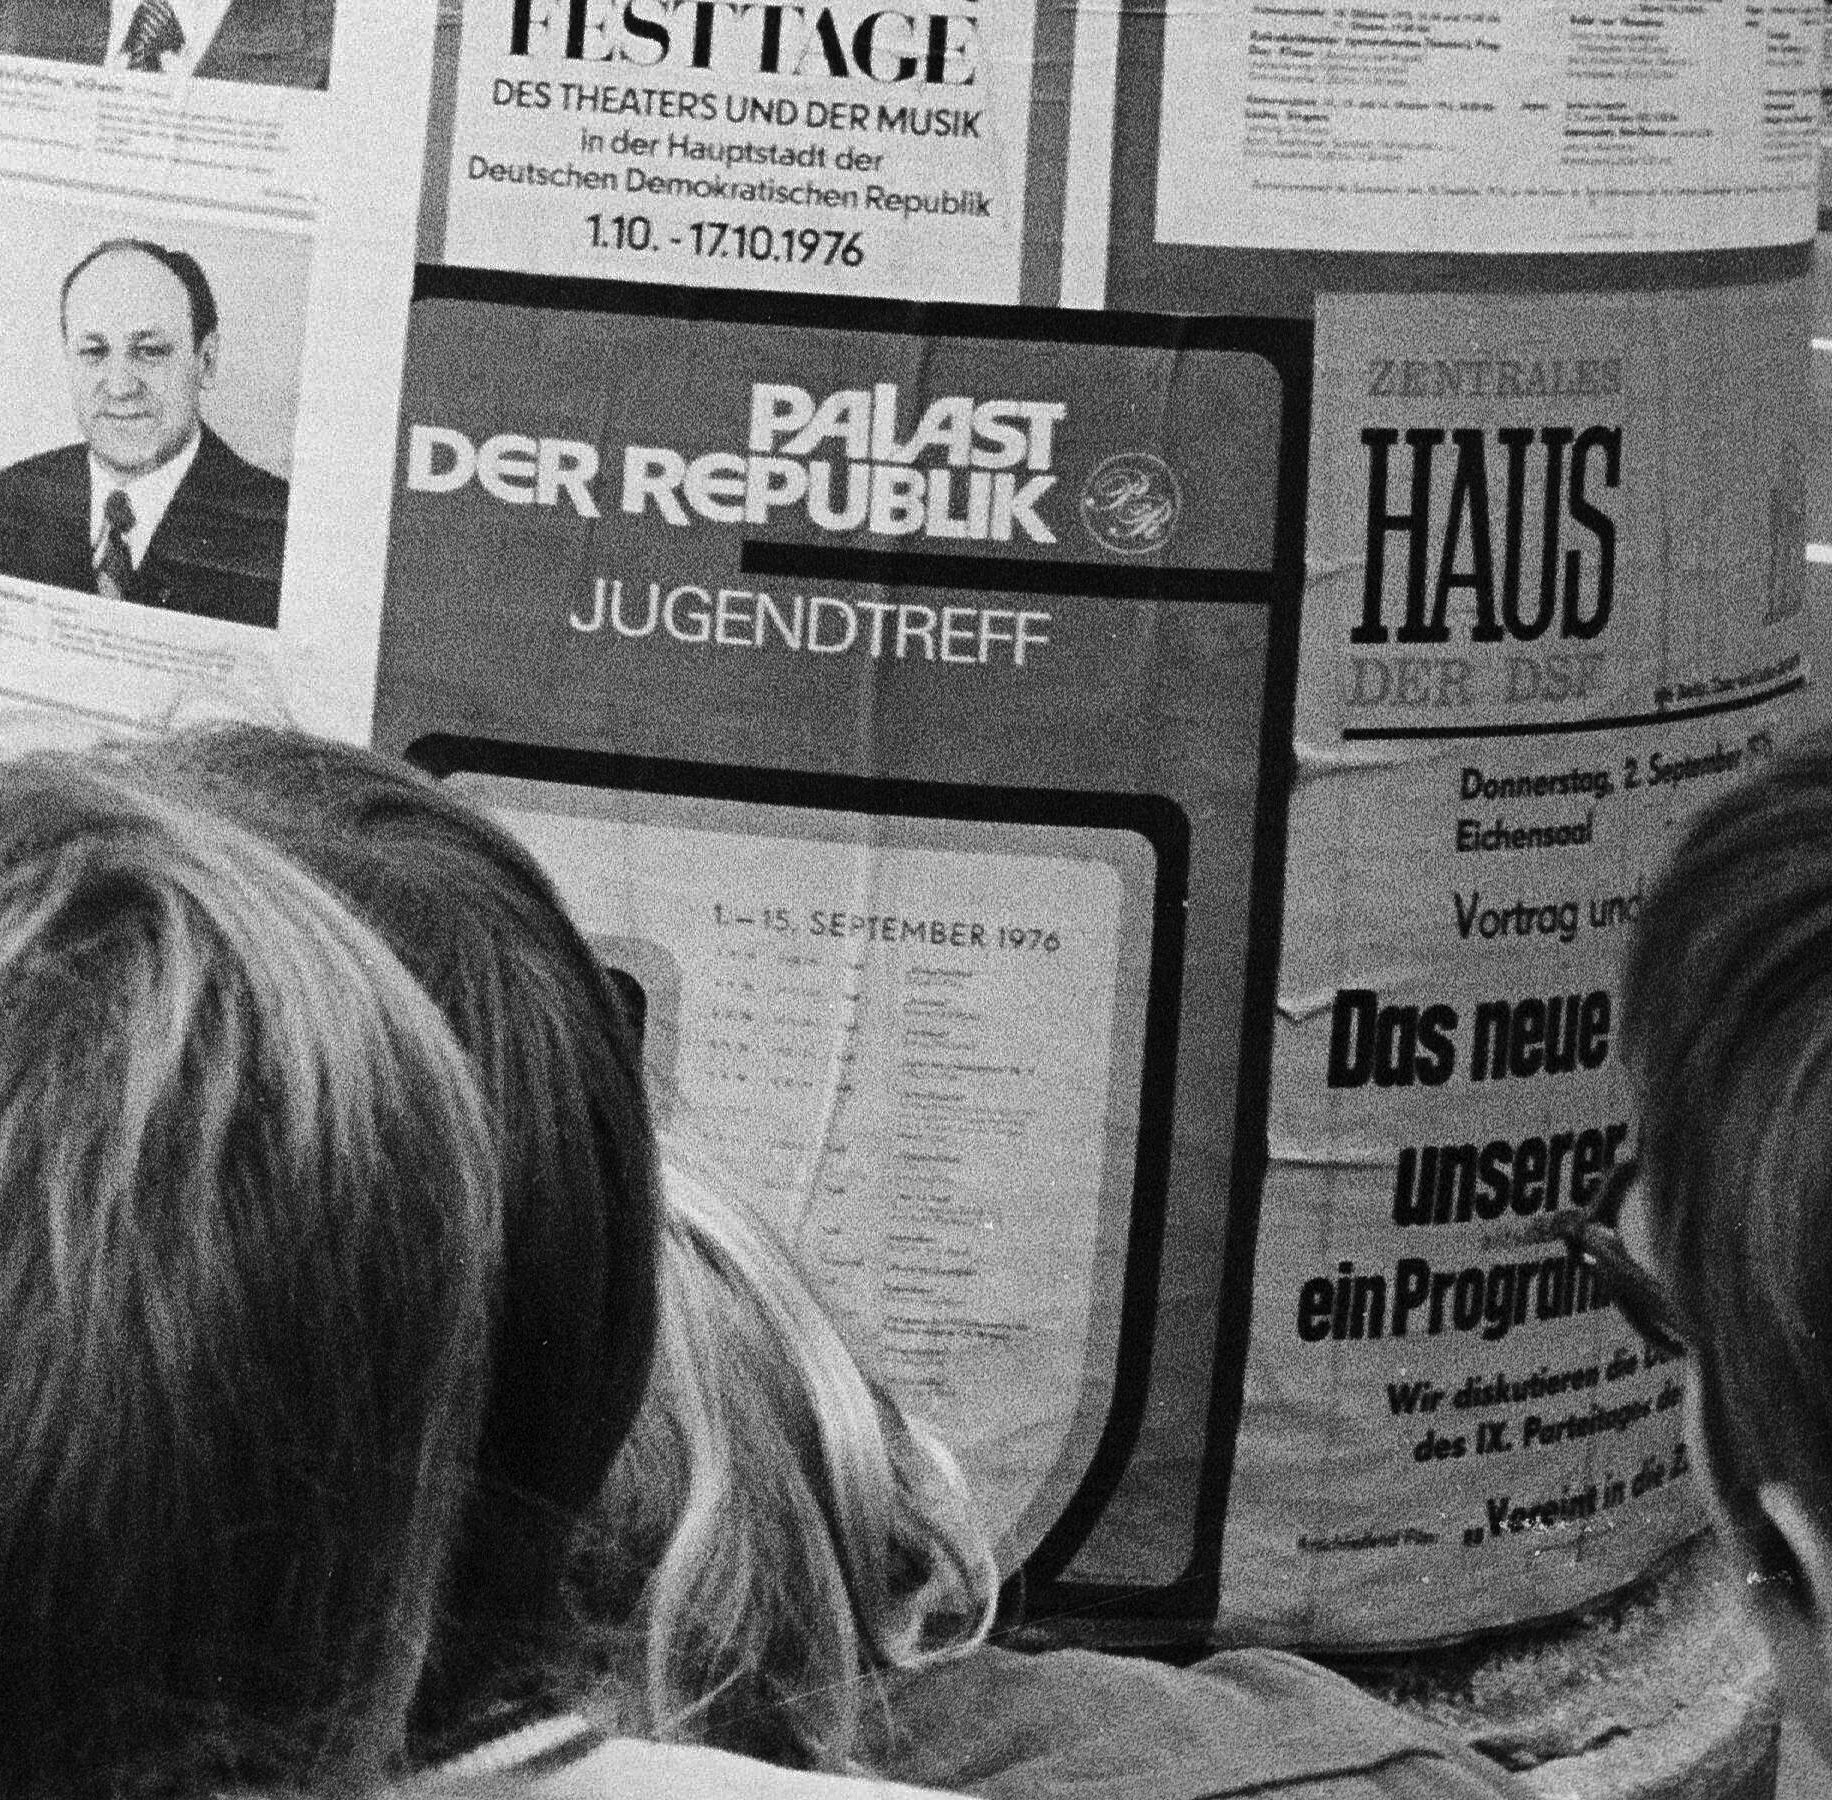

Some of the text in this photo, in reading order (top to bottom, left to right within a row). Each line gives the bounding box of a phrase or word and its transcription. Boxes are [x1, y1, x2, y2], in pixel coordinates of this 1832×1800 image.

[492, 78, 983, 140] DES THEATERS UND DER MUSIK
[611, 128, 660, 157] der
[667, 132, 827, 171] Hauptstadt
[834, 147, 885, 173] der
[468, 154, 992, 219] Deutschen Demokratischen Republik
[1368, 357, 1622, 399] ZENTRALES
[748, 381, 1067, 470] PALAST
[406, 423, 1061, 545] DER REPUBLIK
[1349, 424, 1623, 645] HAUS
[569, 578, 1052, 667] JUGENDTREFF
[1348, 656, 1474, 708] DER
[1455, 806, 1593, 852] Eichensaal
[809, 909, 986, 950] SEPTEMBER
[998, 923, 1061, 953] 1976
[1454, 891, 1579, 943] Vortrag
[1326, 988, 1613, 1089] Das neue
[1392, 1122, 1629, 1228] unserer
[1297, 1259, 1388, 1343] ein
[1387, 1380, 1445, 1415] Wir
[1453, 1366, 1601, 1409] diskutieren
[1413, 1426, 1467, 1463] des
[1476, 1421, 1513, 1455] IX.
[1602, 1472, 1627, 1510] in
[1631, 1452, 1666, 1499] die
